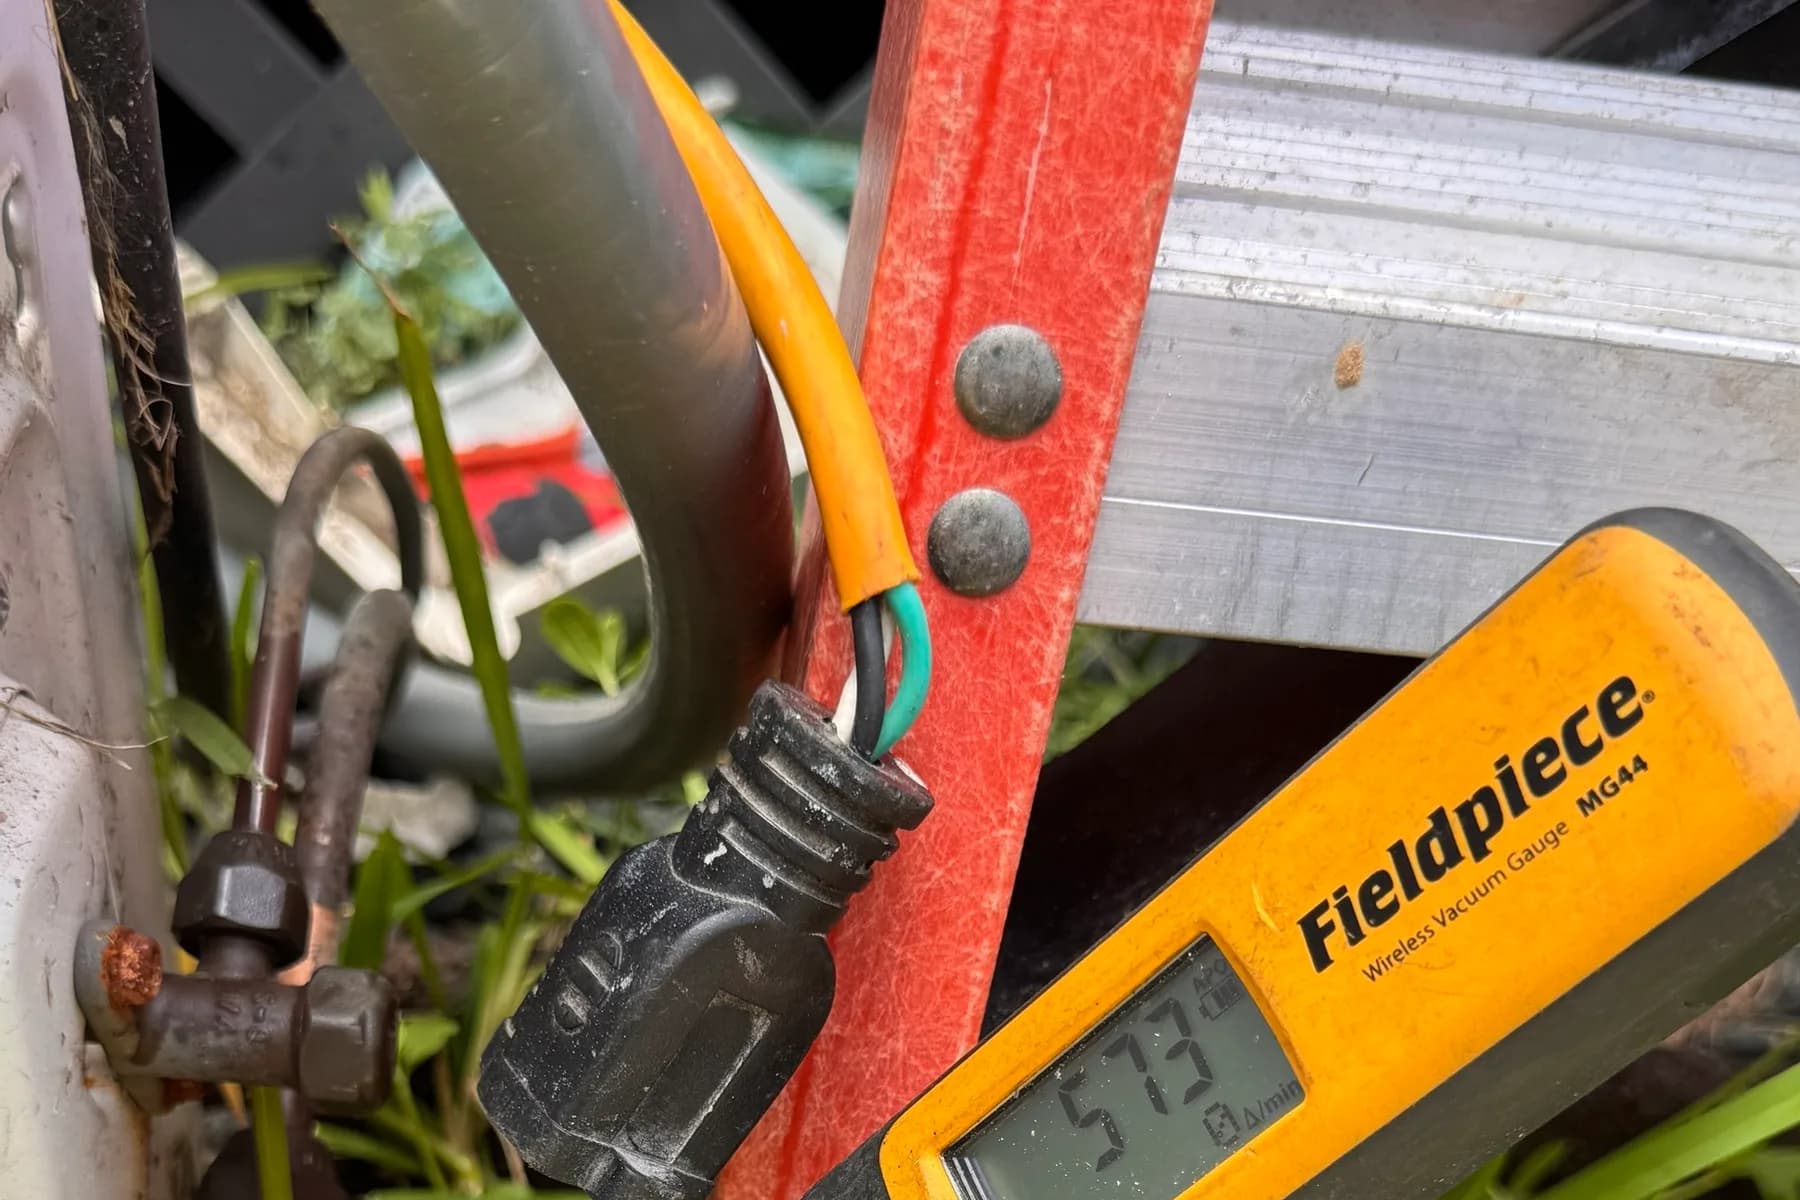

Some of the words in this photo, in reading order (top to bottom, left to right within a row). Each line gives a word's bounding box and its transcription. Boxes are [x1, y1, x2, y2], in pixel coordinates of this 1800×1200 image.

[1361, 925, 1436, 982] Wireless
[1431, 867, 1508, 928] Vacuum
[1507, 819, 1570, 872] Gauge
[1575, 754, 1649, 818] MG44
[1057, 997, 1214, 1173] 573
